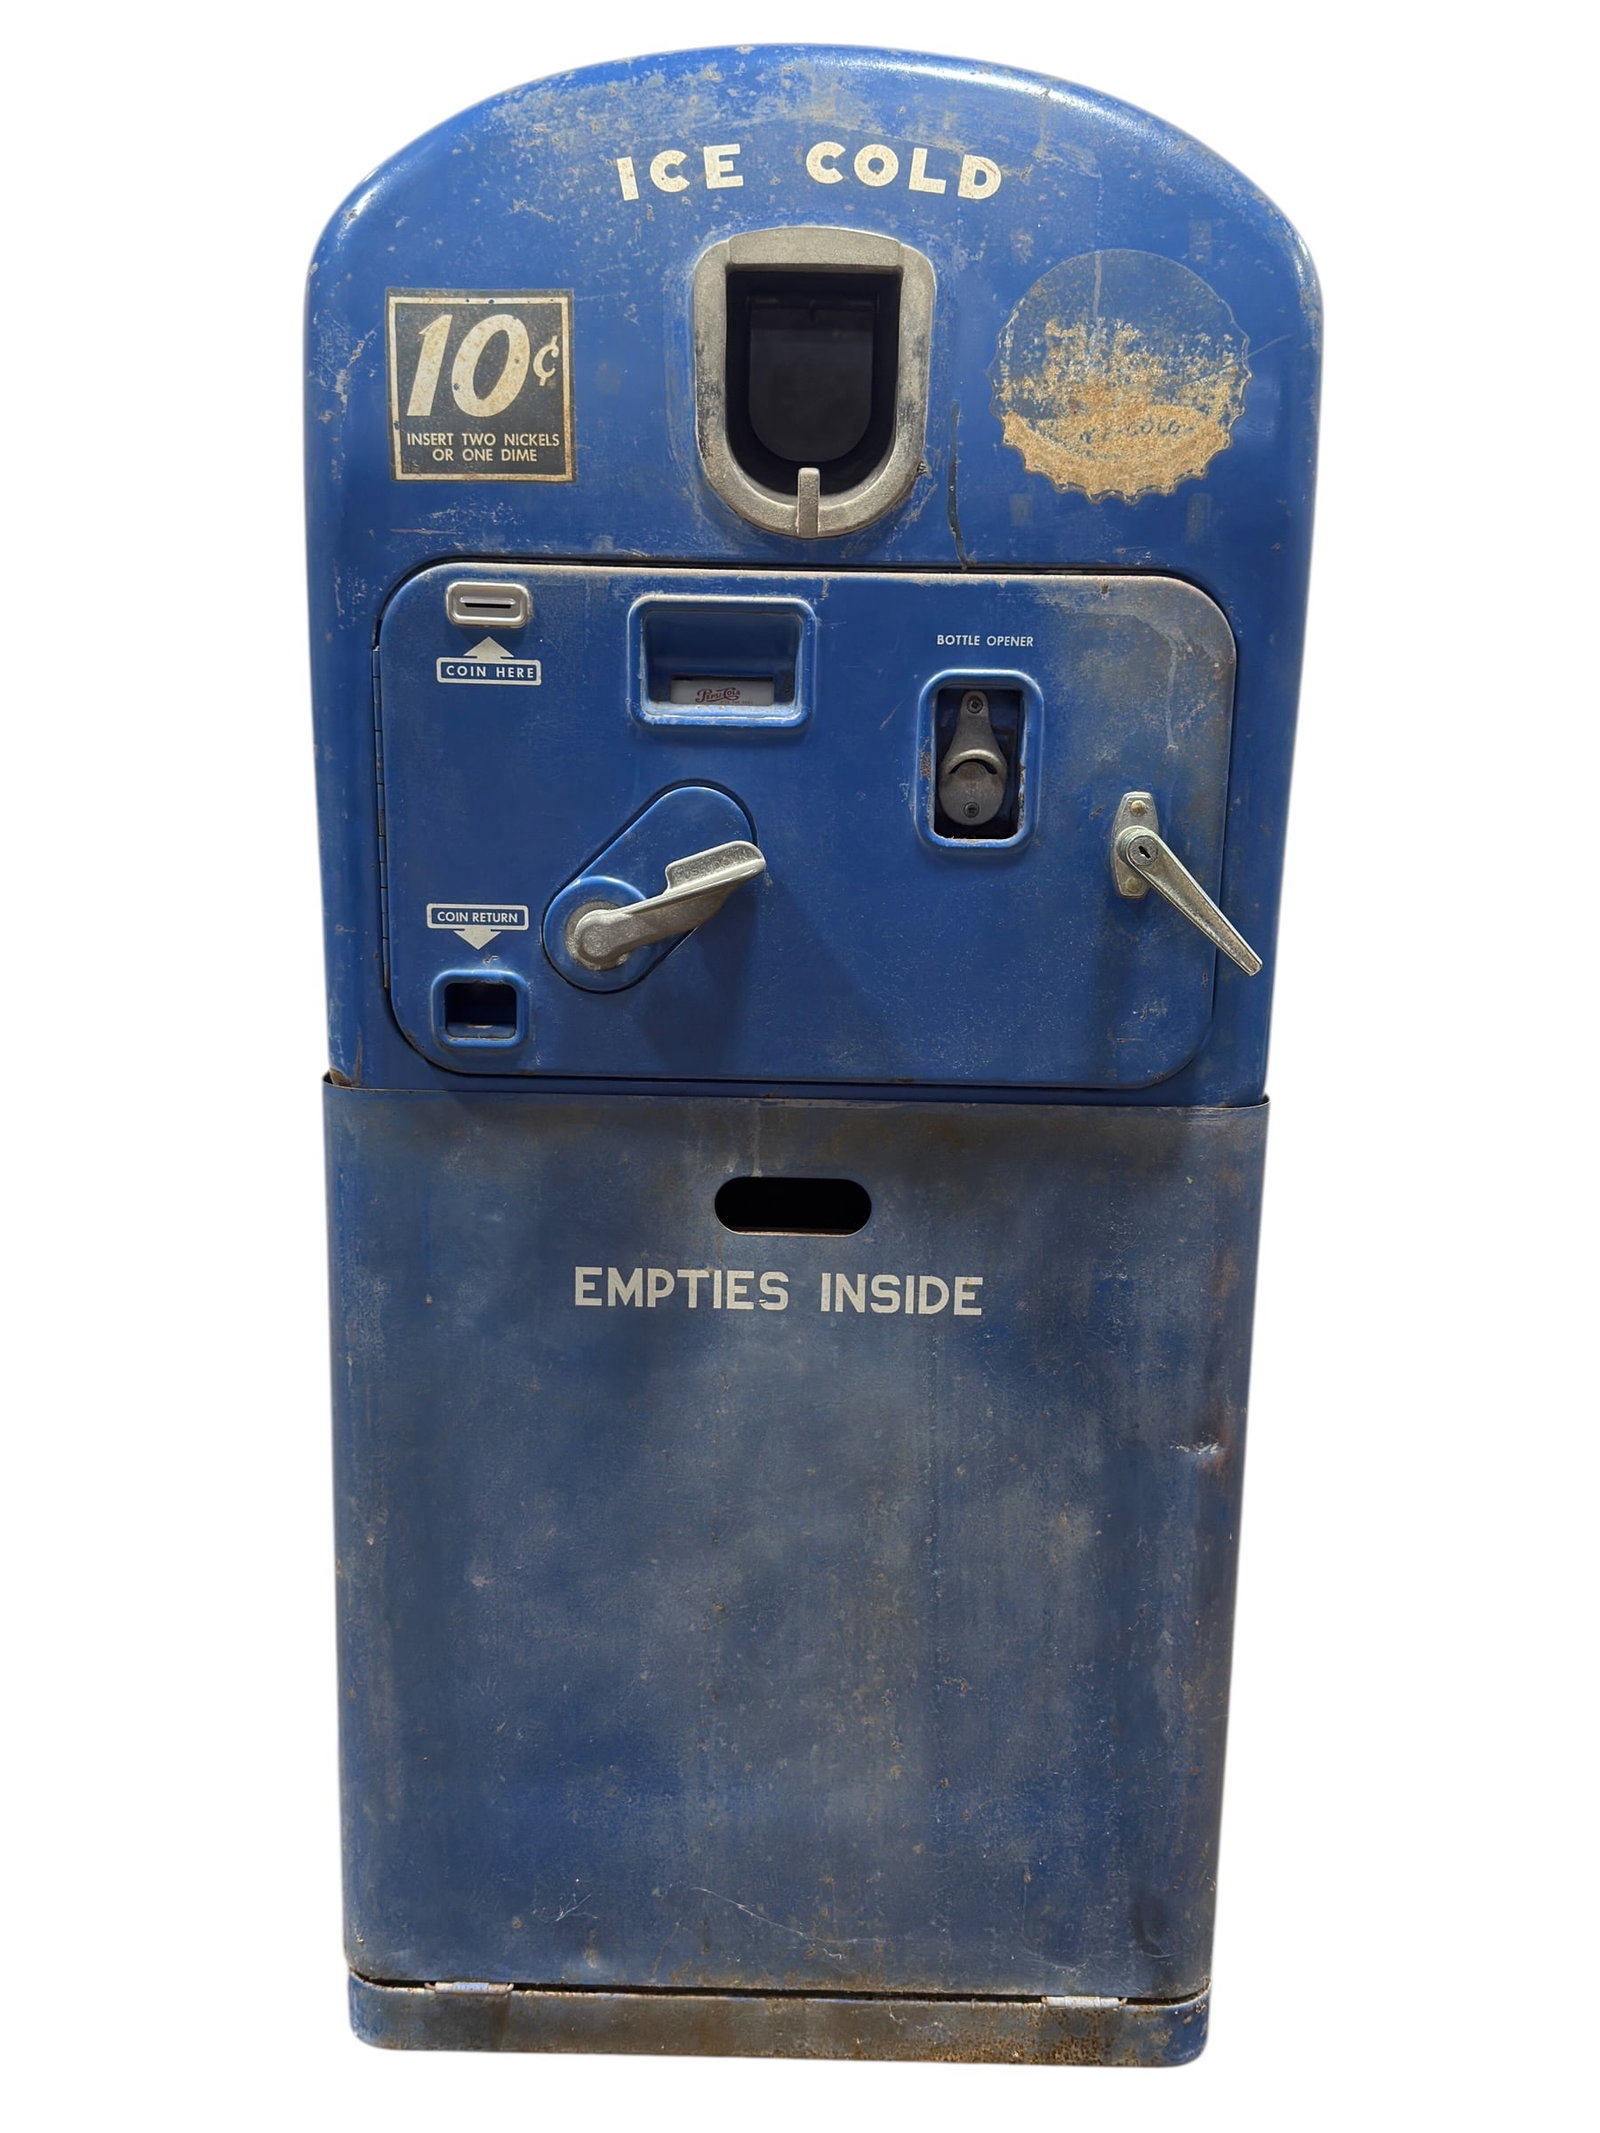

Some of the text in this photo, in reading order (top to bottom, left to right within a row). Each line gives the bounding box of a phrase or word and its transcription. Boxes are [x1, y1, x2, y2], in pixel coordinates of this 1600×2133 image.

[616, 141, 1002, 200] ICE COLD
[406, 313, 560, 418] 10¢
[407, 432, 560, 447] INSERT TWO NICKELS
[432, 449, 538, 462] OR ONE DIME
[937, 634, 1034, 647] BOTTLE OPENER
[446, 665, 534, 679] COIN HERE
[437, 911, 518, 923] COIN RETURN
[574, 1266, 984, 1316] EMPTIES INSIDE
